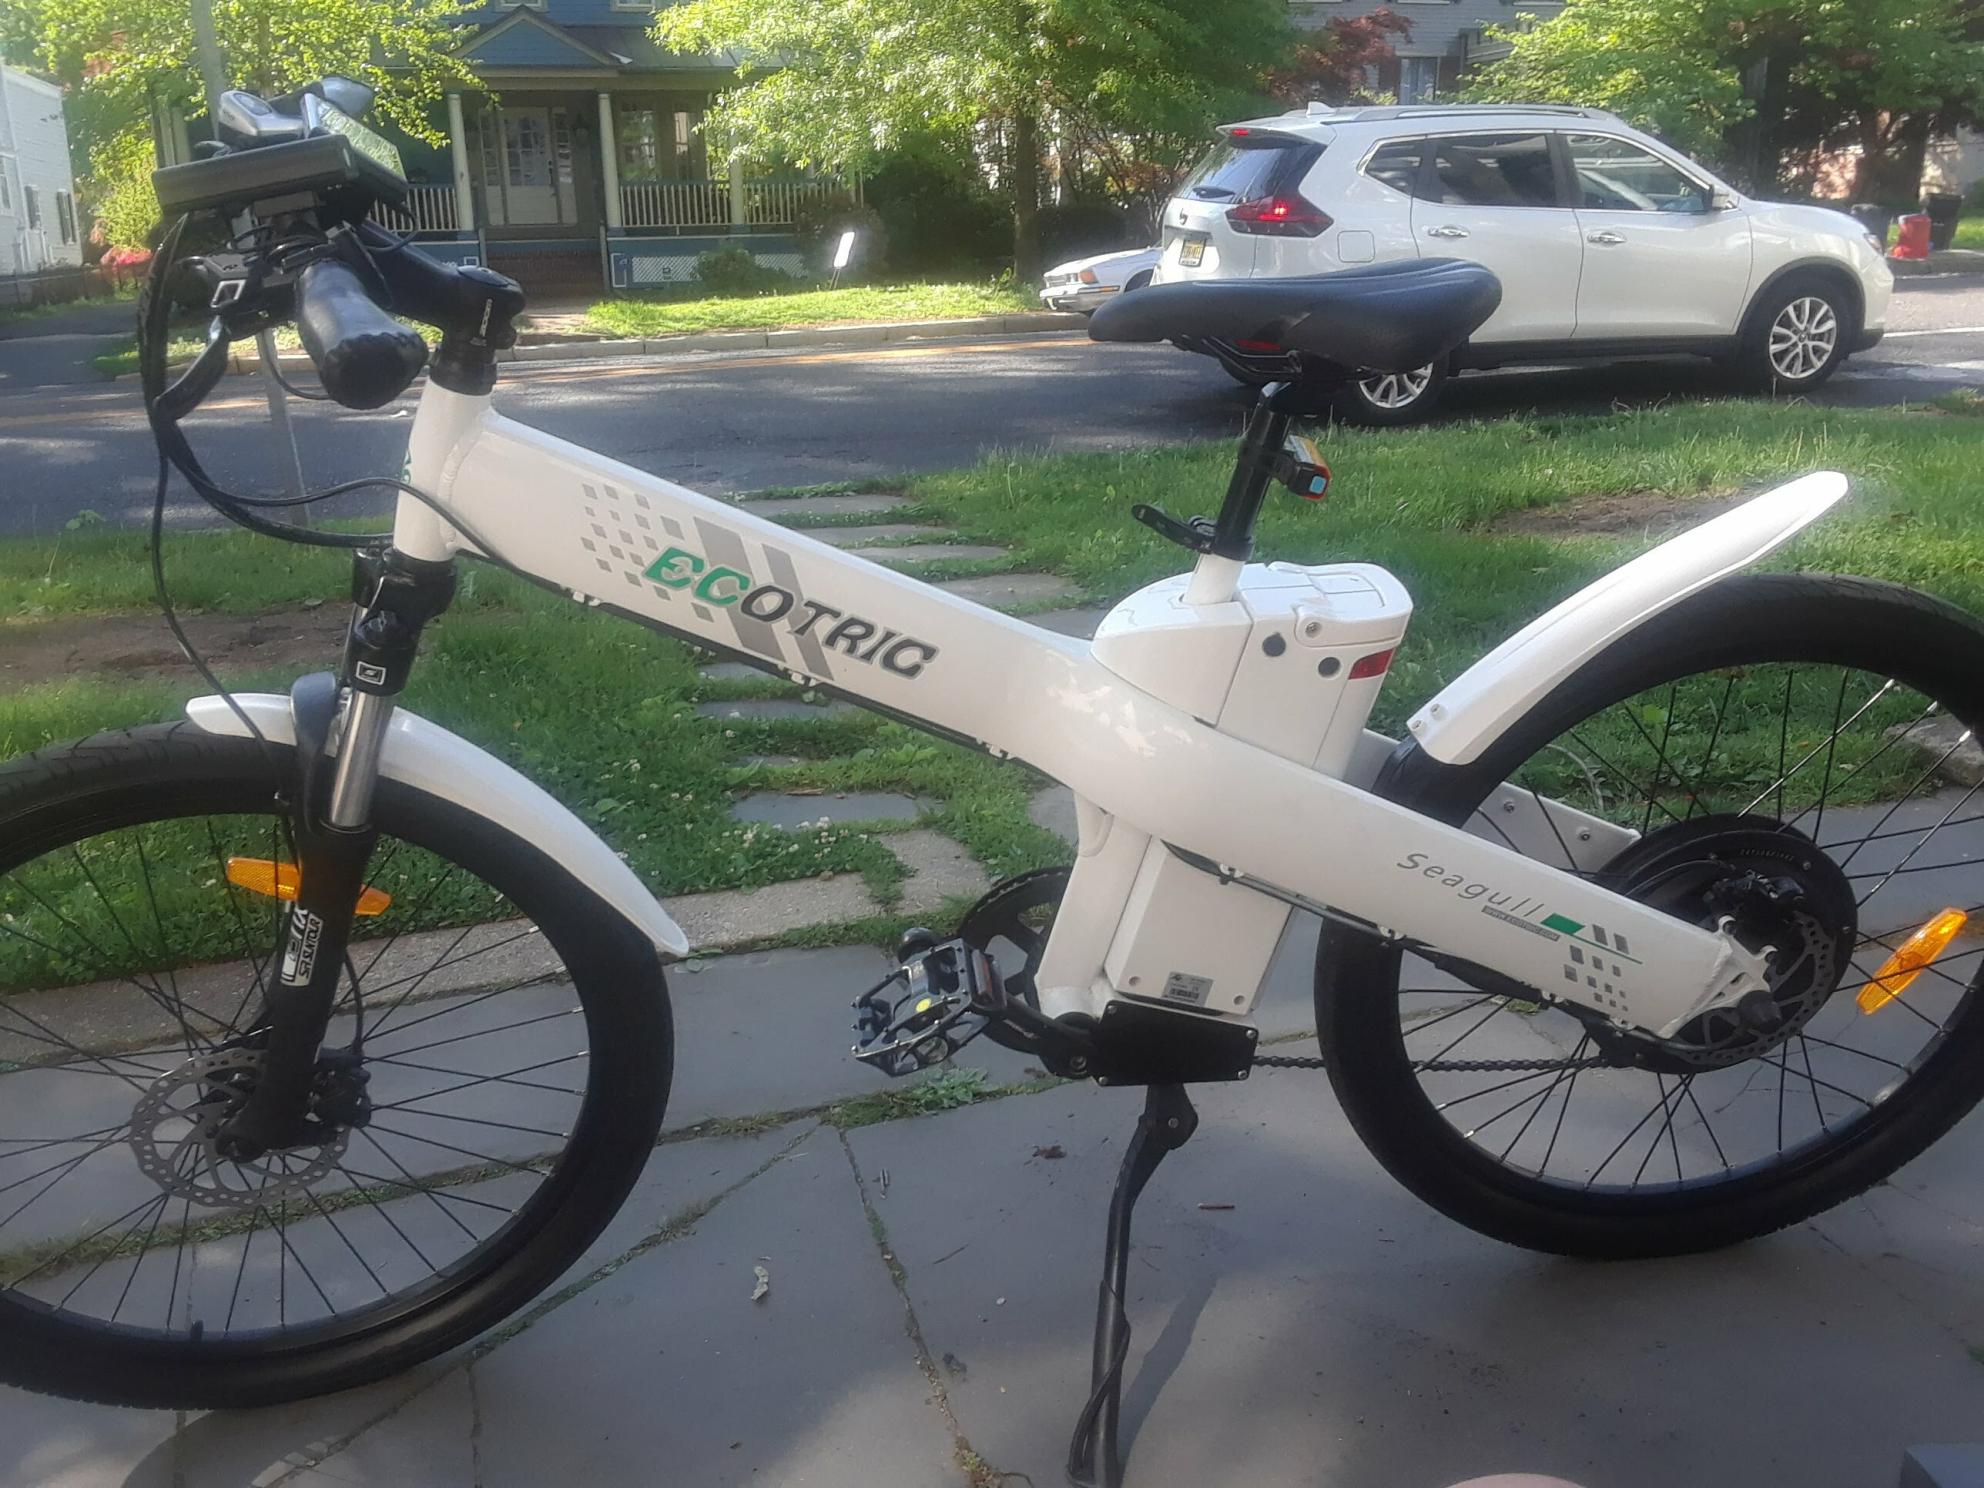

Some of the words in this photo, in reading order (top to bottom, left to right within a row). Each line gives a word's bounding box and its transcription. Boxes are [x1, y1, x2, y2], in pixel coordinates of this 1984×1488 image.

[642, 547, 939, 679] ECOTRIC
[1396, 853, 1545, 917] Seagull
[304, 918, 320, 959] SUNTOUR
